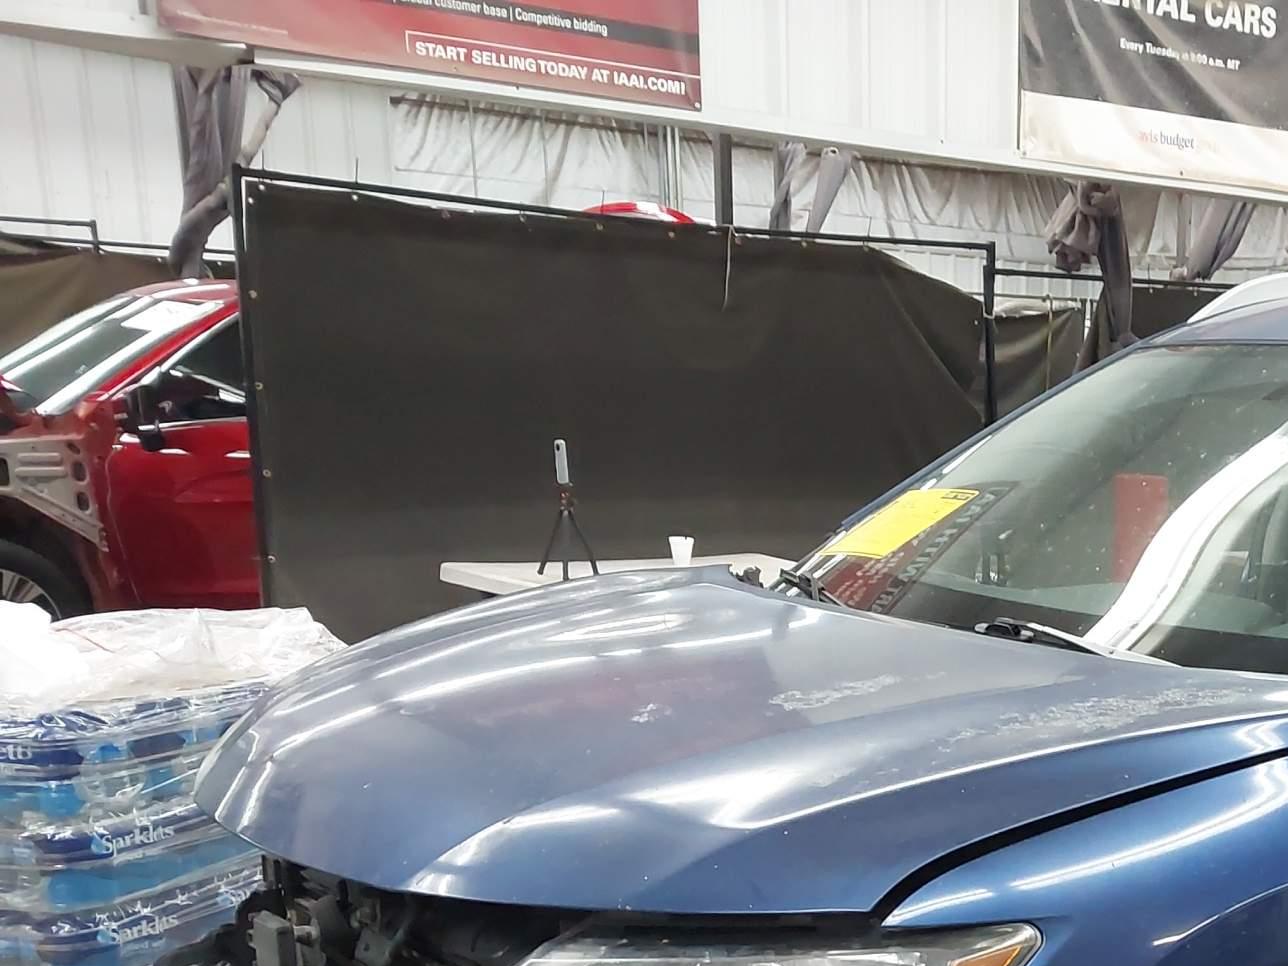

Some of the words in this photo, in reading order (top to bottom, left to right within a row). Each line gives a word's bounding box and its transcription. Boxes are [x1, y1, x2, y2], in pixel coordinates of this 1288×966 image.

[483, 6, 508, 18] base
[515, 8, 572, 28] Competitive
[573, 17, 608, 37] bidding
[1204, 0, 1277, 38] CARS
[1120, 38, 1144, 54] Every
[415, 41, 467, 61] START
[471, 50, 536, 72] SELLING
[537, 60, 588, 80] TODAY
[592, 69, 610, 84] AT
[1160, 131, 1194, 150] budget
